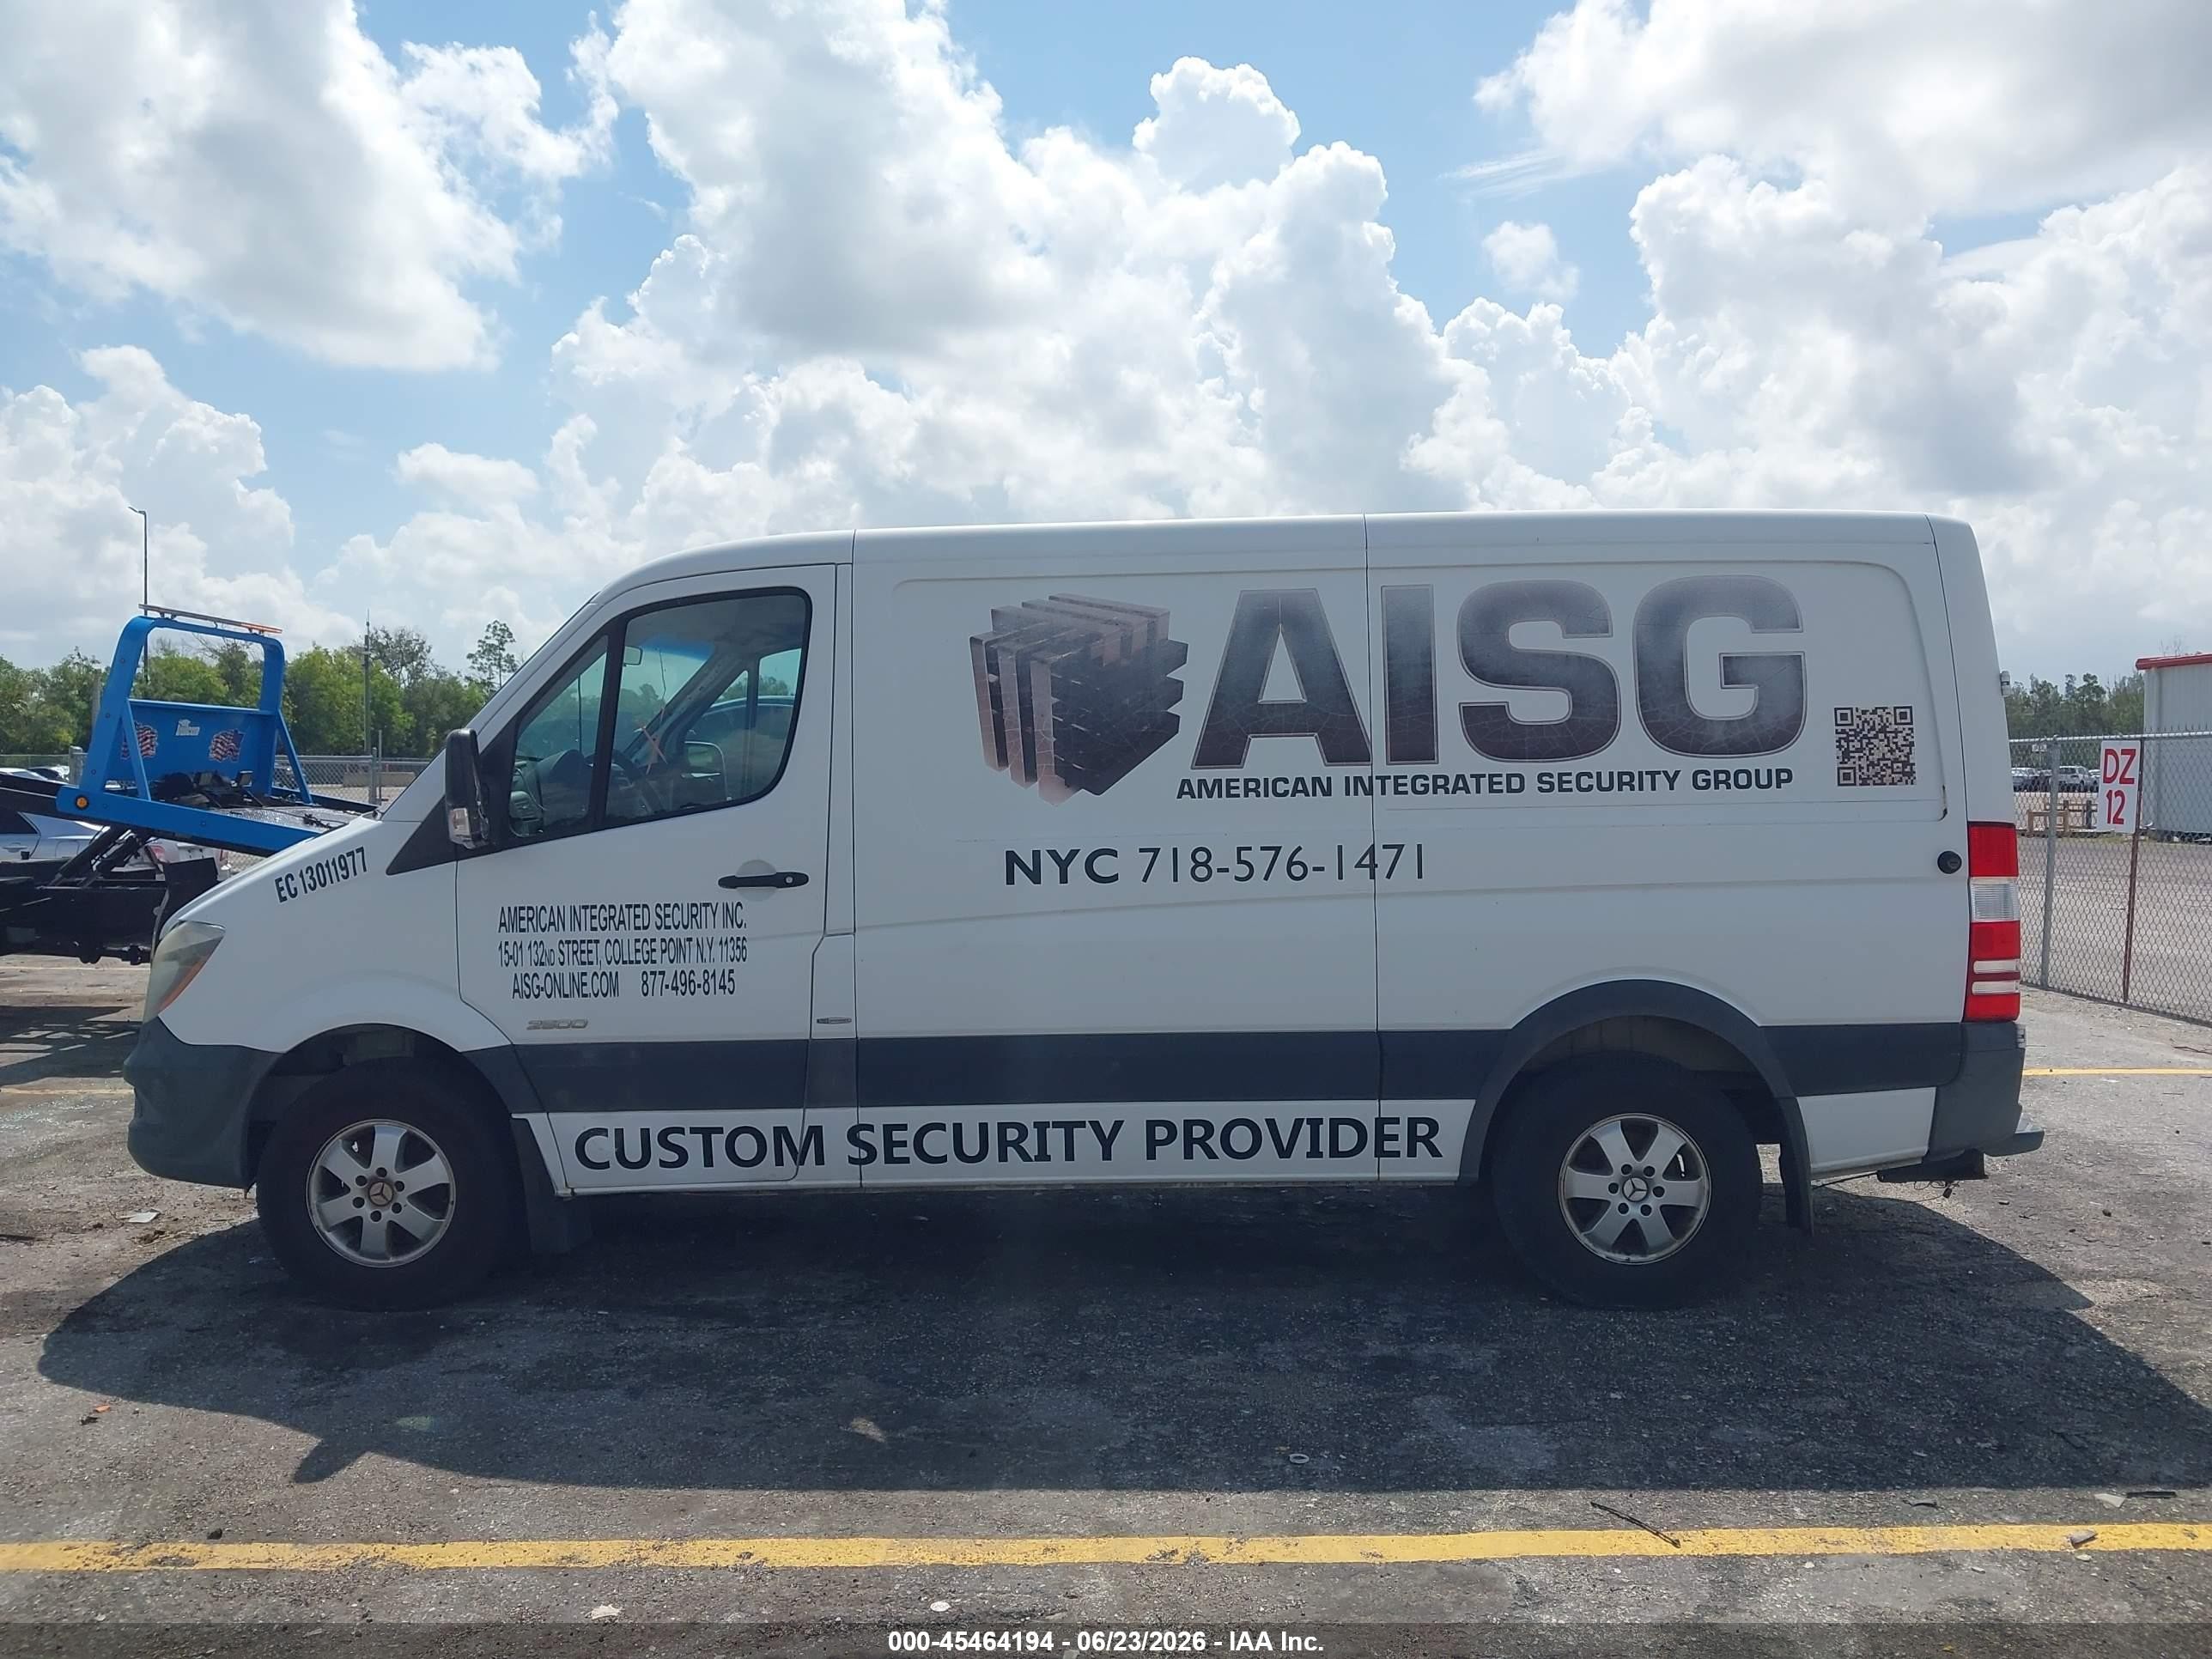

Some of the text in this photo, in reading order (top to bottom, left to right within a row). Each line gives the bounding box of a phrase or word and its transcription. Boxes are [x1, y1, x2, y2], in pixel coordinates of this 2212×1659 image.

[1191, 574, 1808, 770] AISG
[1176, 767, 1793, 799] AMERICAN INTEGRATED SECURITY GROUP
[2103, 748, 2136, 784] DZ
[2106, 789, 2125, 824] 12
[275, 846, 368, 903] EC 13011977
[1005, 843, 1425, 885] NYC 718-576-1471
[498, 901, 747, 933] AMERICAN INTEGRATED SECURITY INC.
[498, 940, 524, 968] 15-01
[558, 939, 602, 970] STREET,
[605, 938, 657, 965] COLLEGE
[660, 937, 693, 964] POINT
[696, 936, 715, 963] N.Y.
[719, 935, 747, 963] 11356
[513, 969, 736, 1000] AISG-ONLINE.COM 877-496-8145
[574, 1115, 1443, 1170] CUSTOM SECURITY PROVIDER
